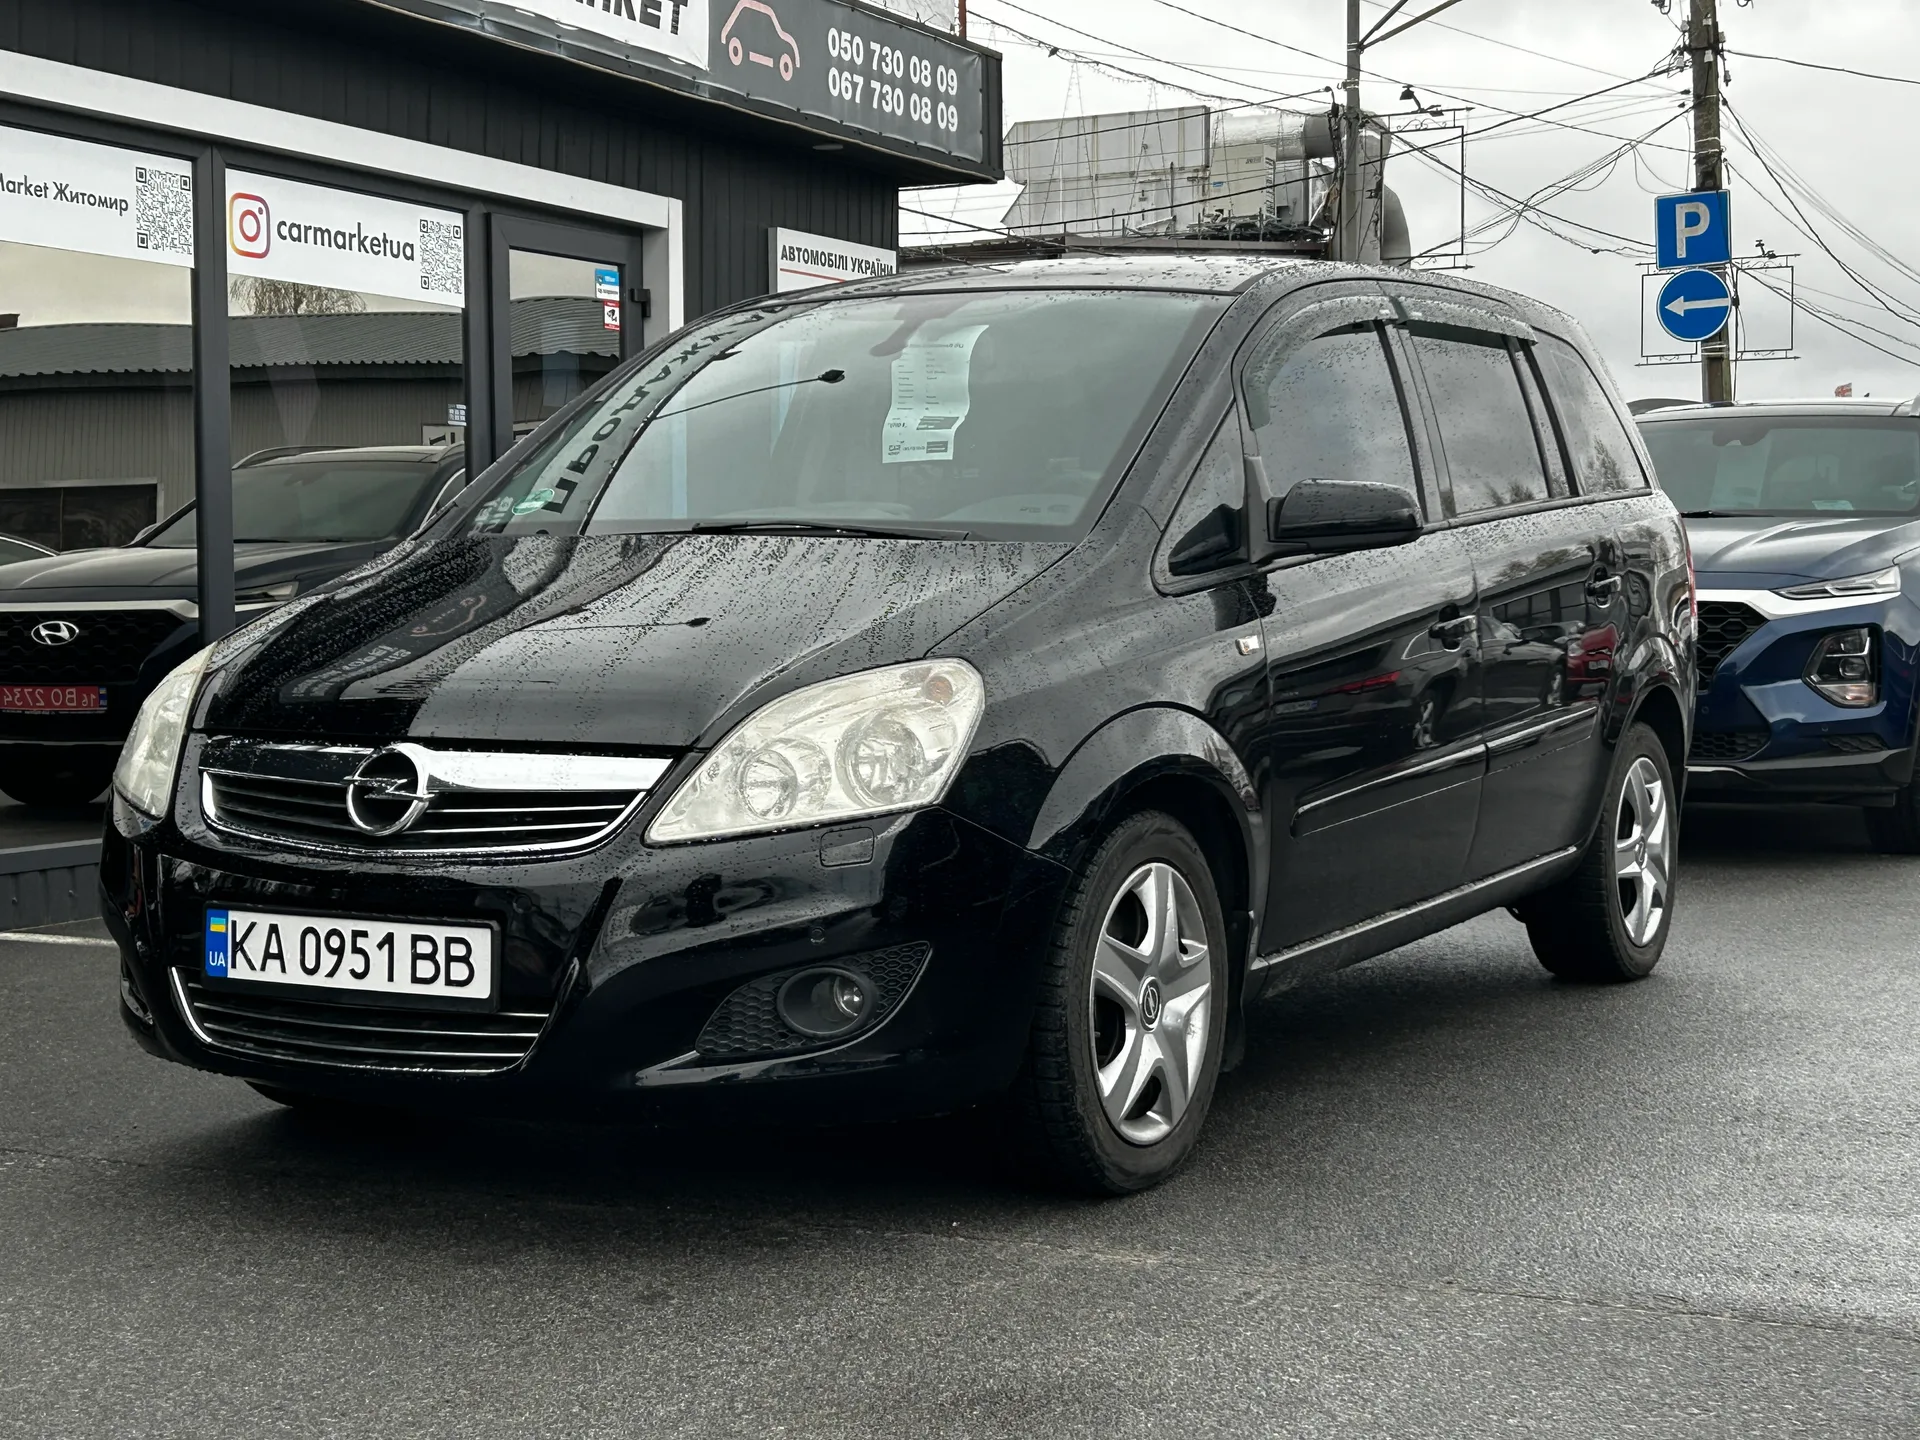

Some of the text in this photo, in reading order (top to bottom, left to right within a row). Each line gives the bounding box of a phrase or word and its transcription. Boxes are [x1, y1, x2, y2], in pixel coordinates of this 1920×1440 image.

[828, 27, 958, 95] 050 730 08 09
[828, 67, 958, 132] 067 730 08 09
[53, 181, 129, 217] Житомир
[277, 220, 415, 261] carmarketua
[1675, 202, 1710, 259] P
[781, 244, 848, 271] АВТОМОБІЛІ
[209, 951, 226, 967] UA
[231, 919, 475, 987] KA 0951 BB
